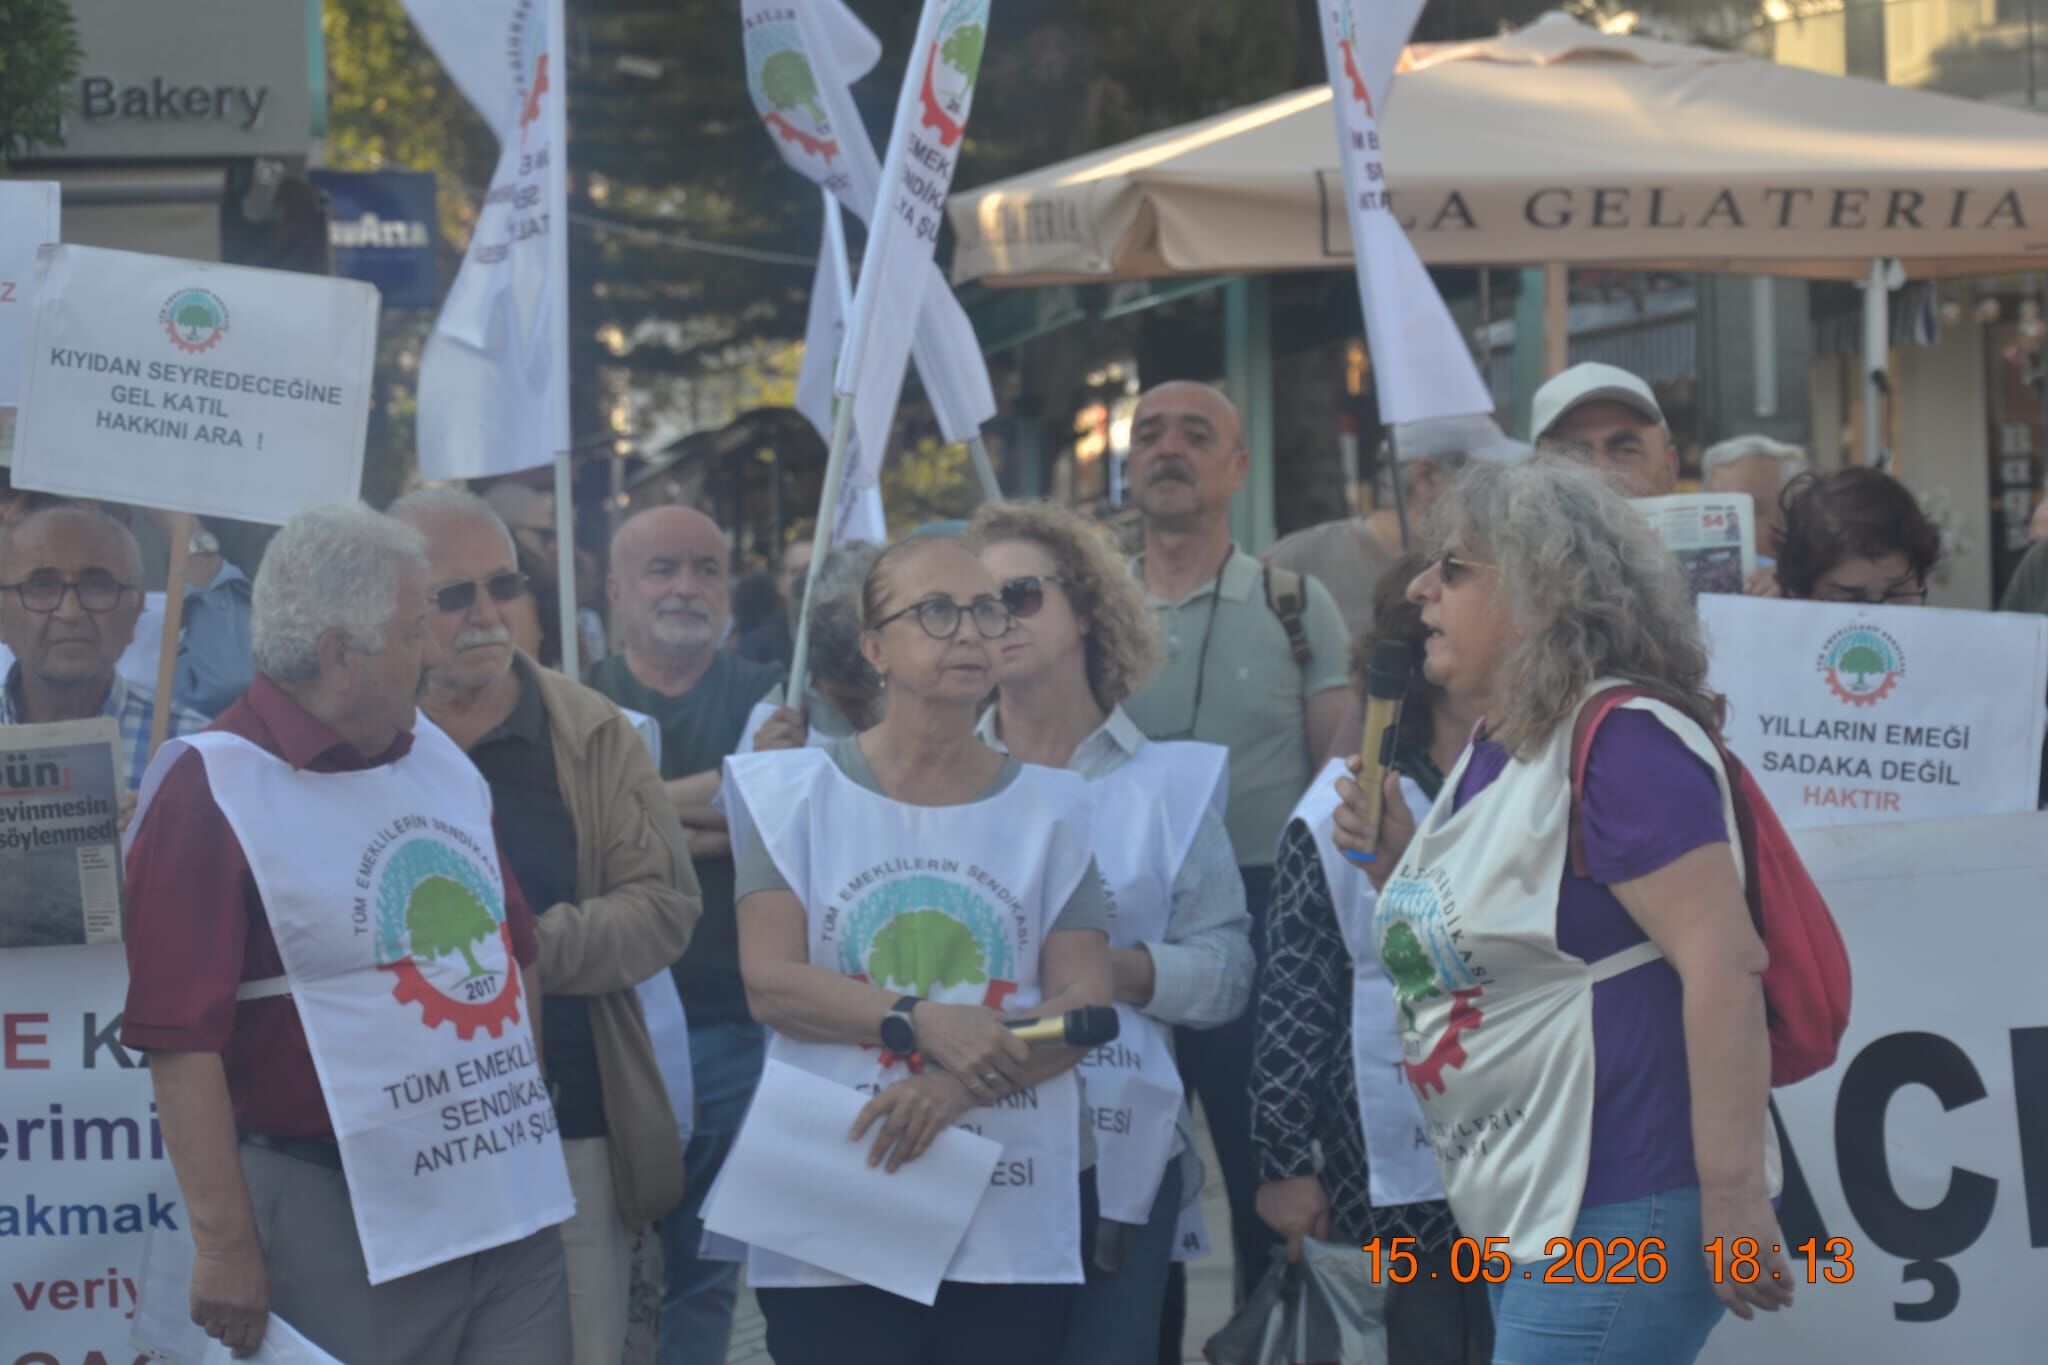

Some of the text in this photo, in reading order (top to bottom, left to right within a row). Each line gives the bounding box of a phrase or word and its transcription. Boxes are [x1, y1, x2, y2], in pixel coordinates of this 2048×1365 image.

[81, 76, 268, 131] Bakery
[1524, 185, 2031, 231] GELATERIA
[50, 348, 343, 405] KIYIDAN SEYREDECEĞİNE
[111, 385, 229, 418] GEL KATIL
[96, 410, 188, 440] HAKKINI
[194, 424, 243, 448] ARA
[1759, 715, 1970, 750] YILLARIN EMEĞİ
[0, 754, 60, 789] ün
[1762, 751, 1961, 786] SADAKA DEĞİL
[1802, 785, 1901, 812] HAKTIR
[465, 974, 498, 1002] 2017
[83, 1012, 150, 1070] K
[383, 1069, 450, 1109] TÜM
[0, 1102, 164, 1162] rimi
[414, 1119, 527, 1177] ANTALYA
